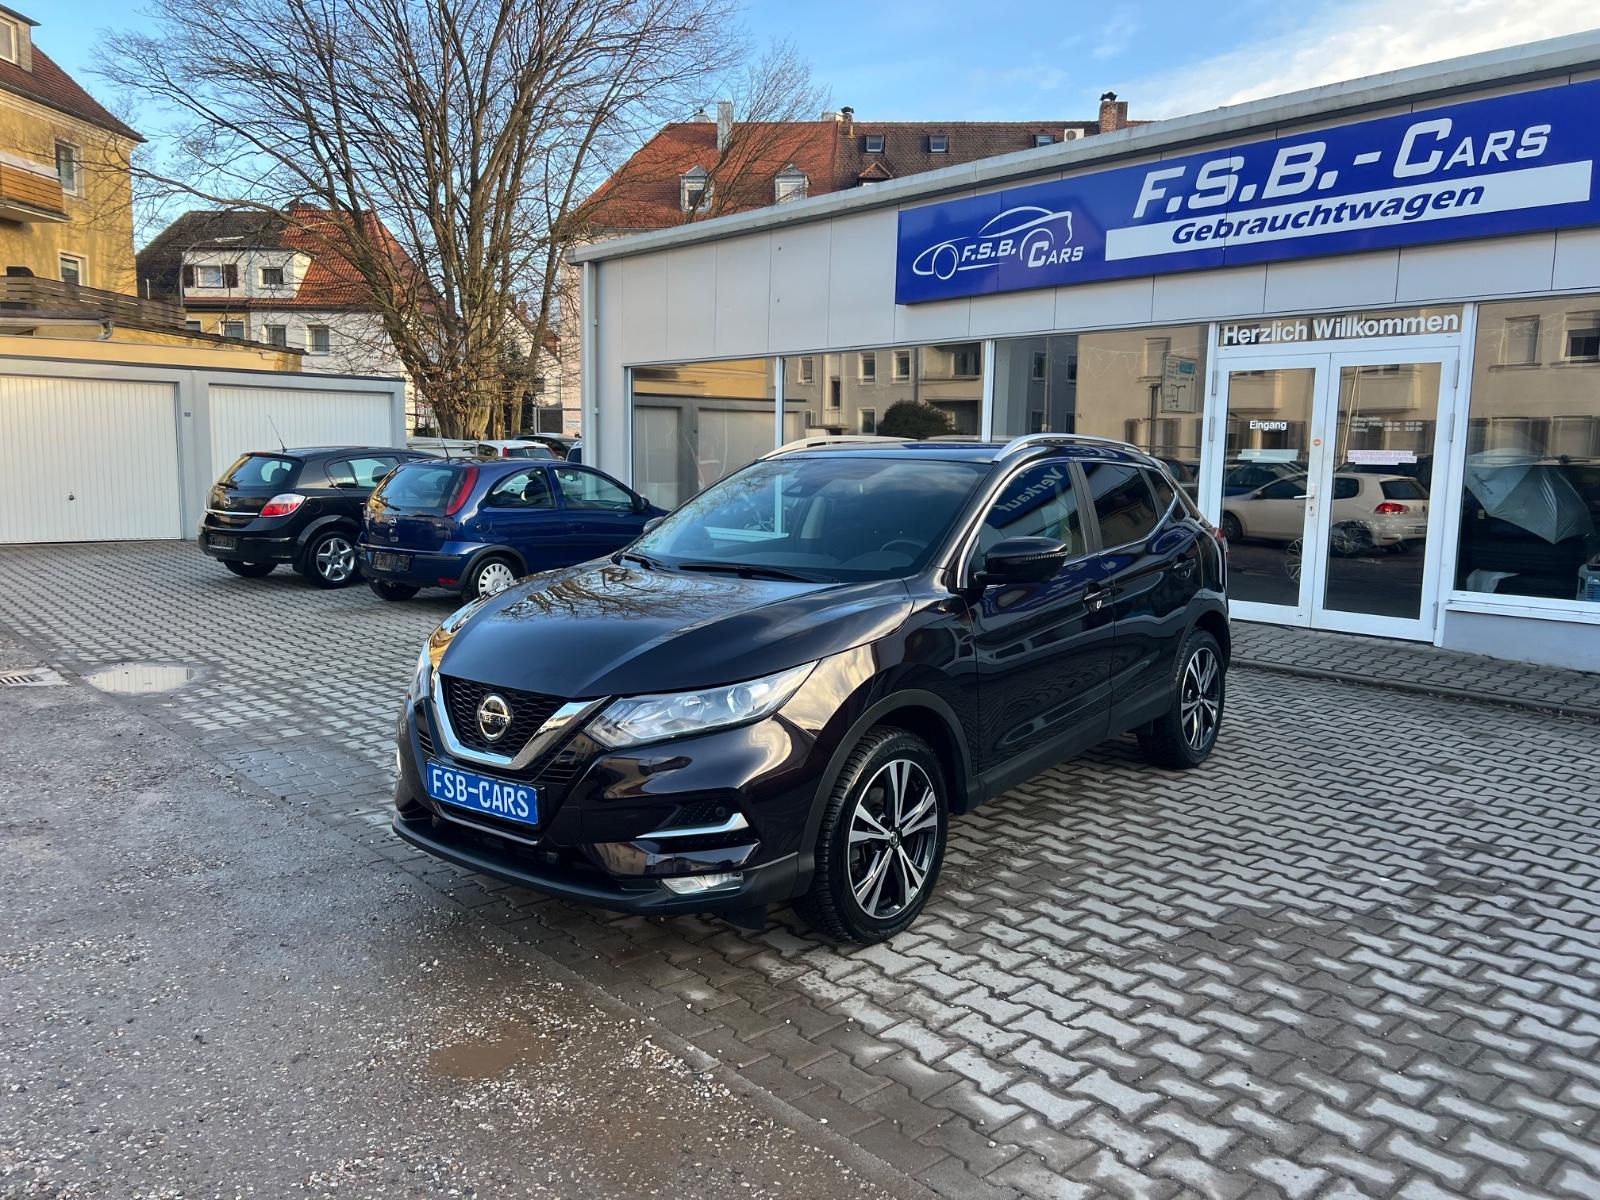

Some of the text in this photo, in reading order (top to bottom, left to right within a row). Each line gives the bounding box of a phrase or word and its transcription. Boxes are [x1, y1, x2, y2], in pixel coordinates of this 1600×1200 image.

[1132, 141, 1339, 219] F.S.B.
[1171, 185, 1485, 244] Gebrauchtwagen
[961, 239, 1017, 262] F.S.B.
[1223, 314, 1459, 345] Herzlich Willkommen
[1249, 419, 1287, 431] Eingang
[432, 768, 529, 817] FSB-CARS
